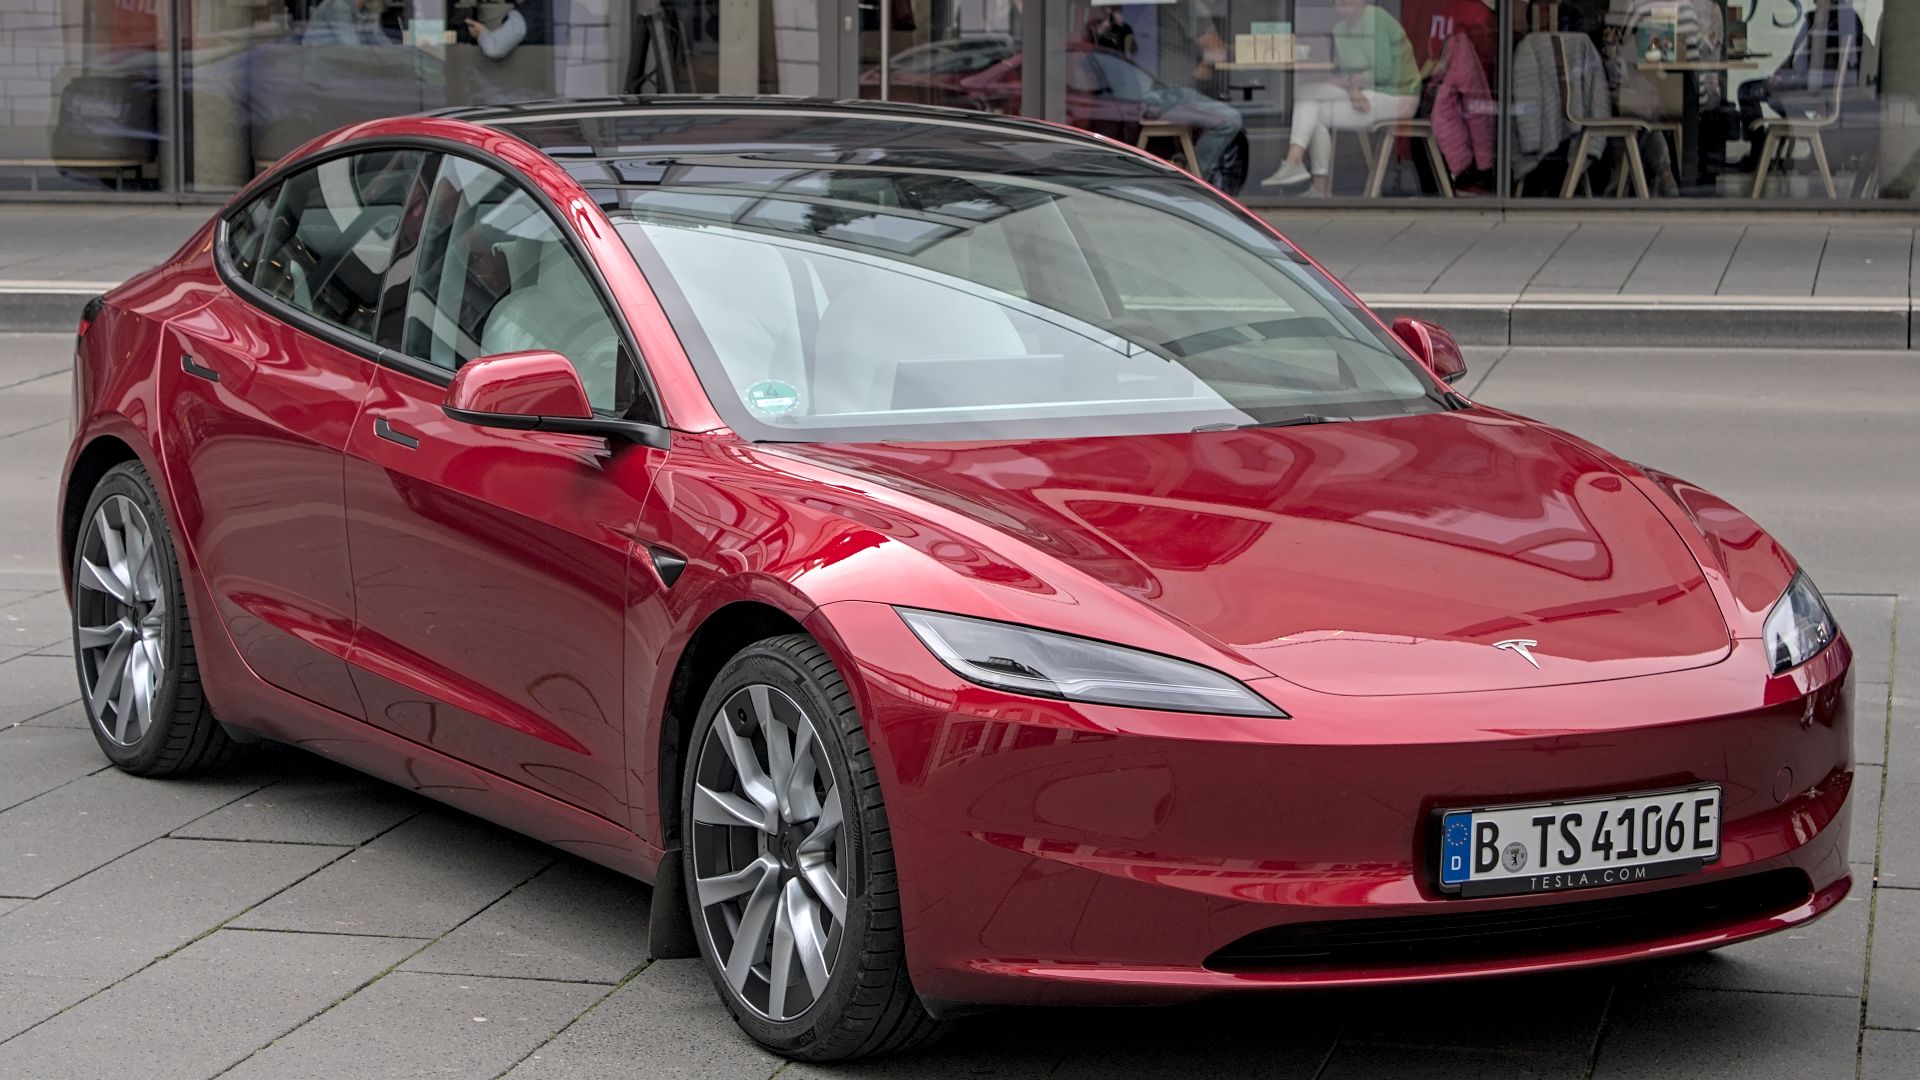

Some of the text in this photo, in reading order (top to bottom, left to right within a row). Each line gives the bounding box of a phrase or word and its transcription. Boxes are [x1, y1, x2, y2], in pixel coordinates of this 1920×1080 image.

[1475, 821, 1500, 874] B
[1532, 812, 1583, 868] TS
[1451, 855, 1462, 871] D
[1530, 866, 1646, 890] TESLA.COM
